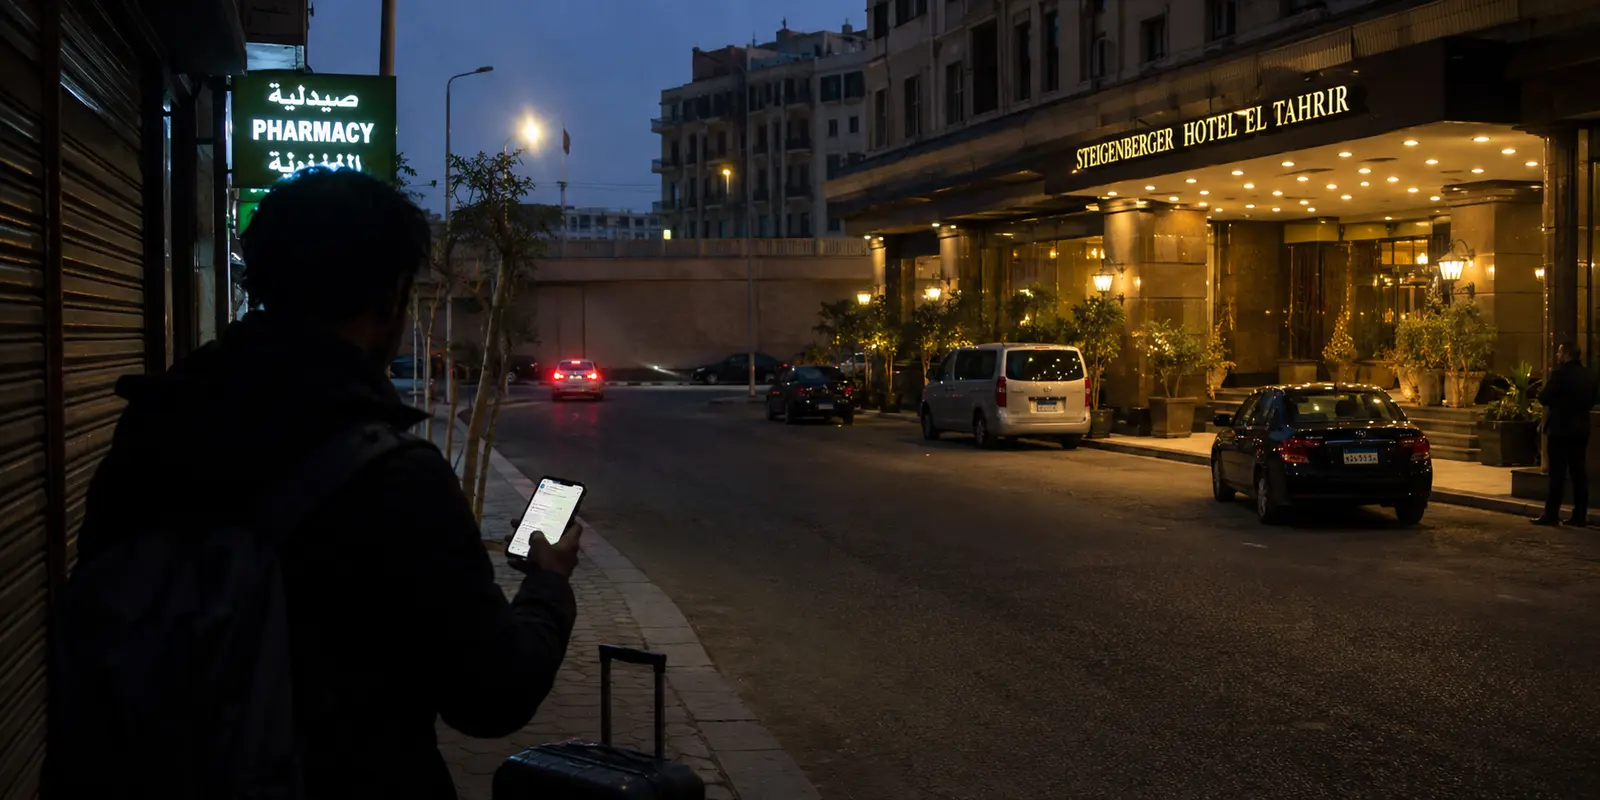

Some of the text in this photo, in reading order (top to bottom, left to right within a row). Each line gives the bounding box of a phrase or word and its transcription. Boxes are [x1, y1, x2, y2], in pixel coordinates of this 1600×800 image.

[268, 82, 359, 113] صيدلية
[252, 118, 375, 144] PHARMACY
[1076, 85, 1350, 170] STEIGENBERGER HOTEL EL TAHRIR
